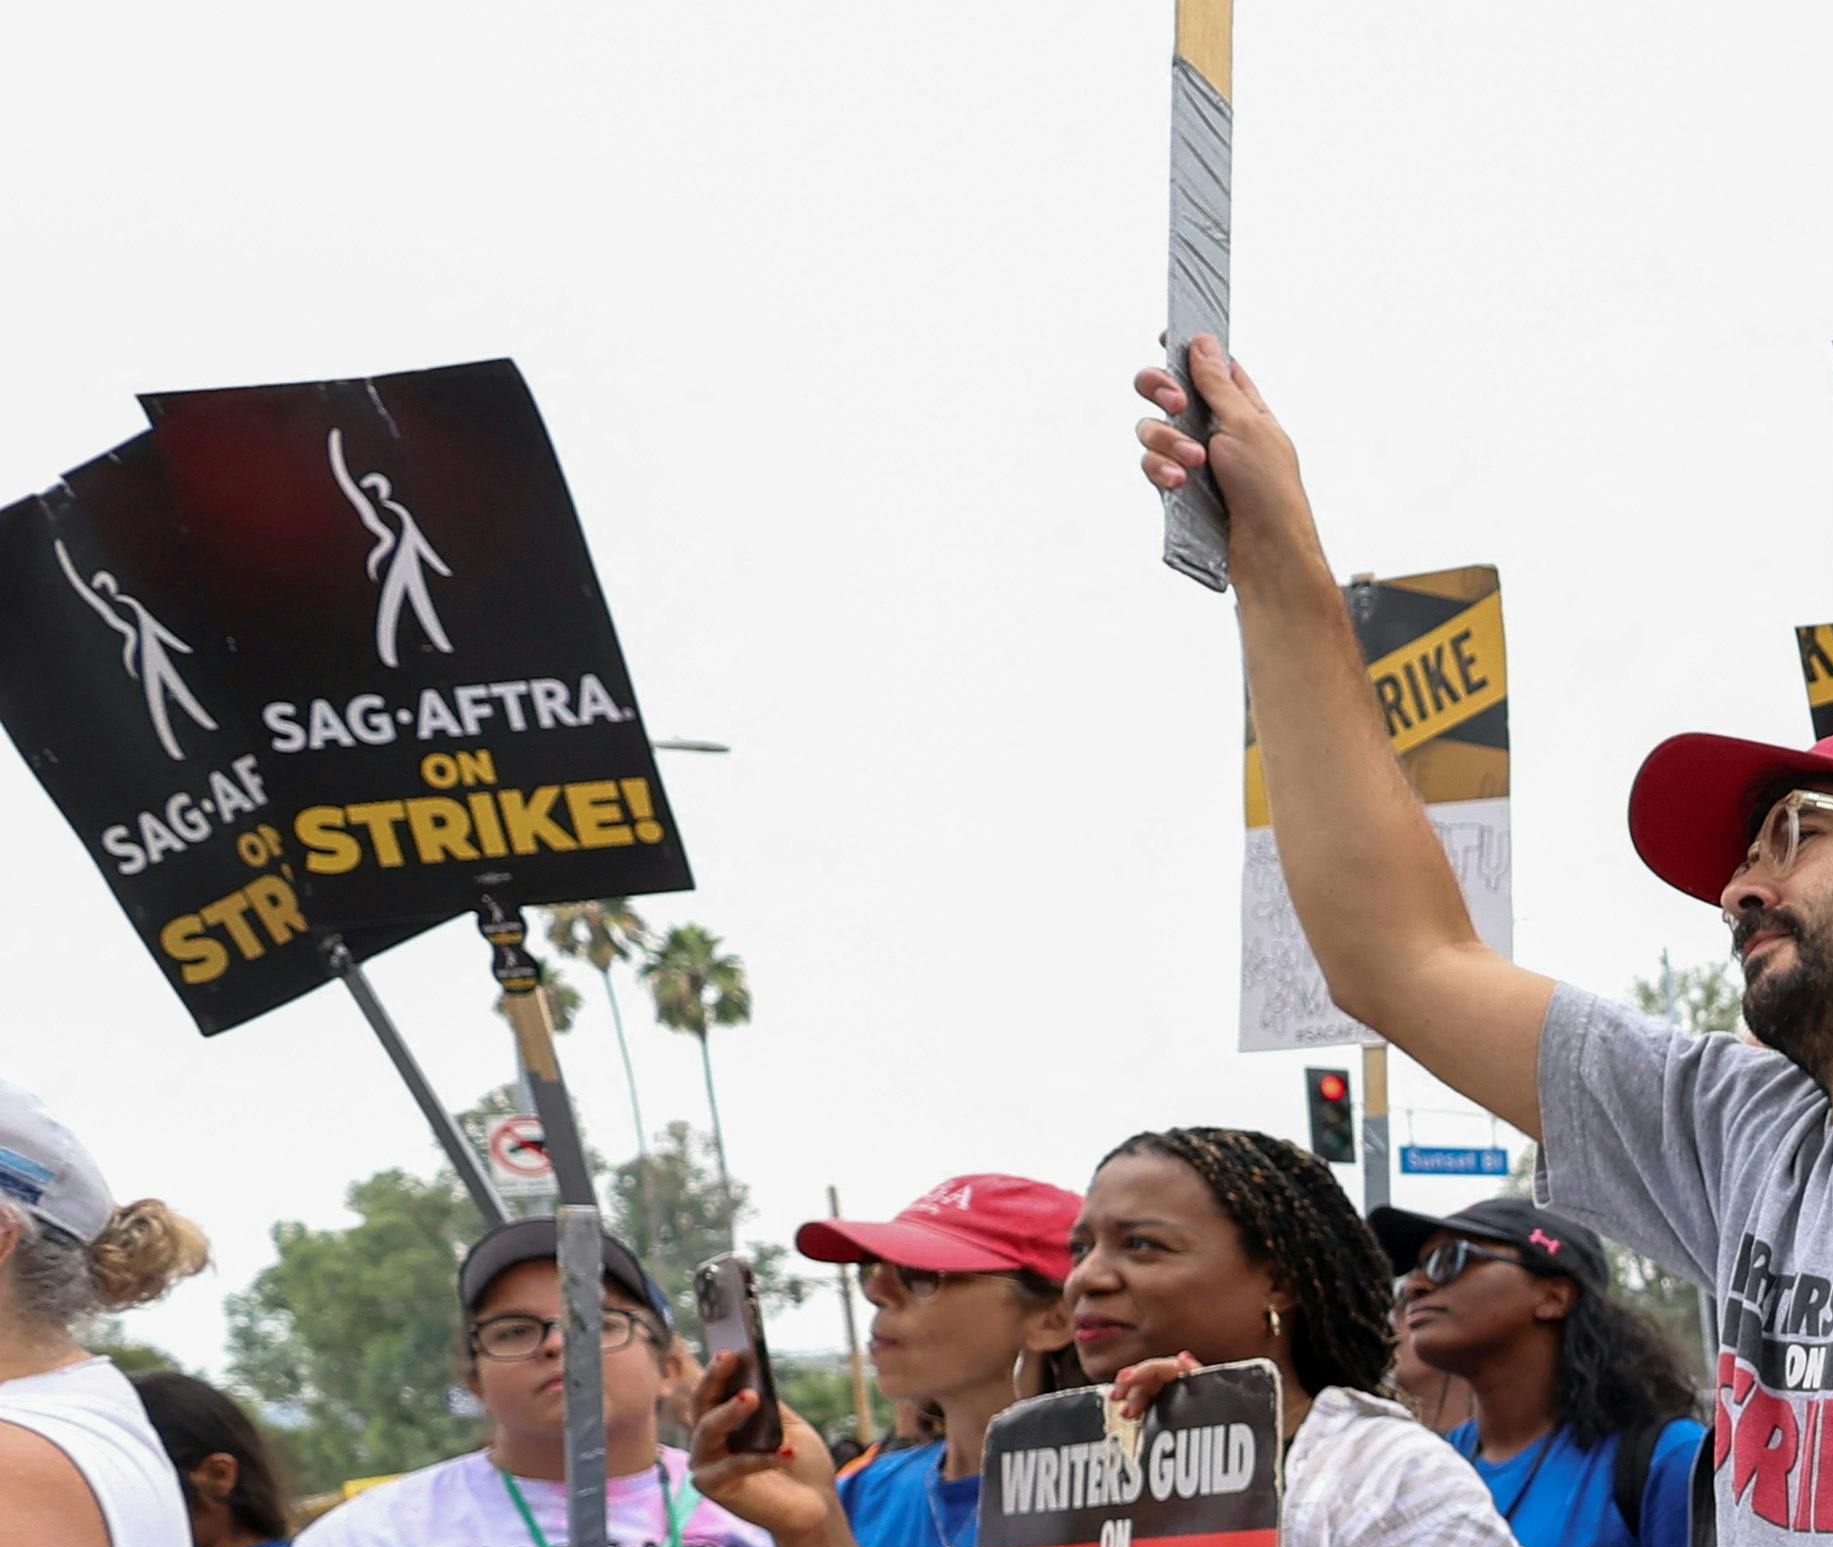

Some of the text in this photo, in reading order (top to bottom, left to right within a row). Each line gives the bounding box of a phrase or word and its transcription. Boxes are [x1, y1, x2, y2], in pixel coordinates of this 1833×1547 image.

[1374, 627, 1489, 737] RIKE
[420, 749, 497, 790] ON
[293, 777, 665, 876] STRIKE!
[159, 864, 310, 986] STR
[1785, 1344, 1826, 1389] ON
[1001, 1422, 1256, 1516] WRITERS GUILD
